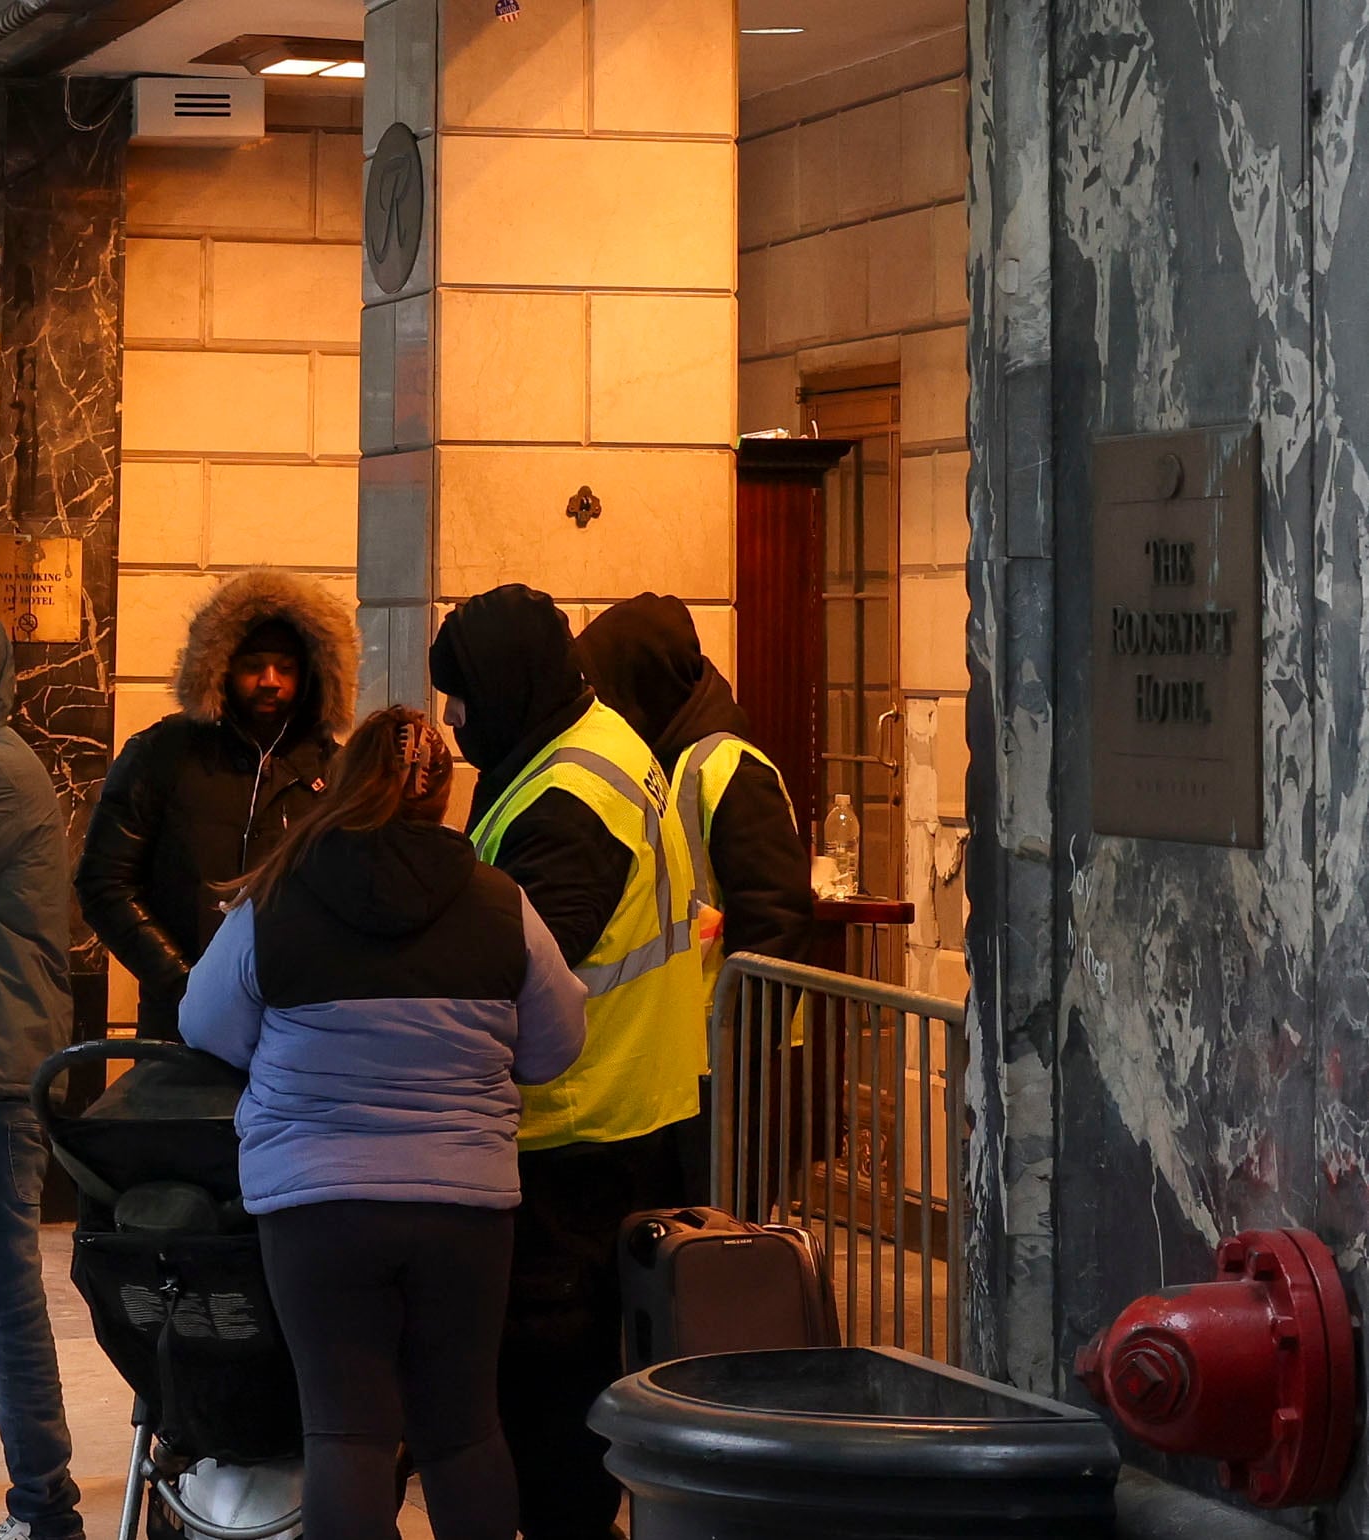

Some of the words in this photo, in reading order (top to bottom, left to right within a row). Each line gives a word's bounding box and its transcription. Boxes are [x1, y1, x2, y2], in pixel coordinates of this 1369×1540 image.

[16, 572, 61, 582] SMOKING
[1145, 538, 1196, 587] THE
[19, 584, 54, 594] FRONT
[20, 597, 55, 605] HOTEL
[1111, 602, 1236, 657] ROOSEVELT
[1135, 672, 1212, 725] HOTEL
